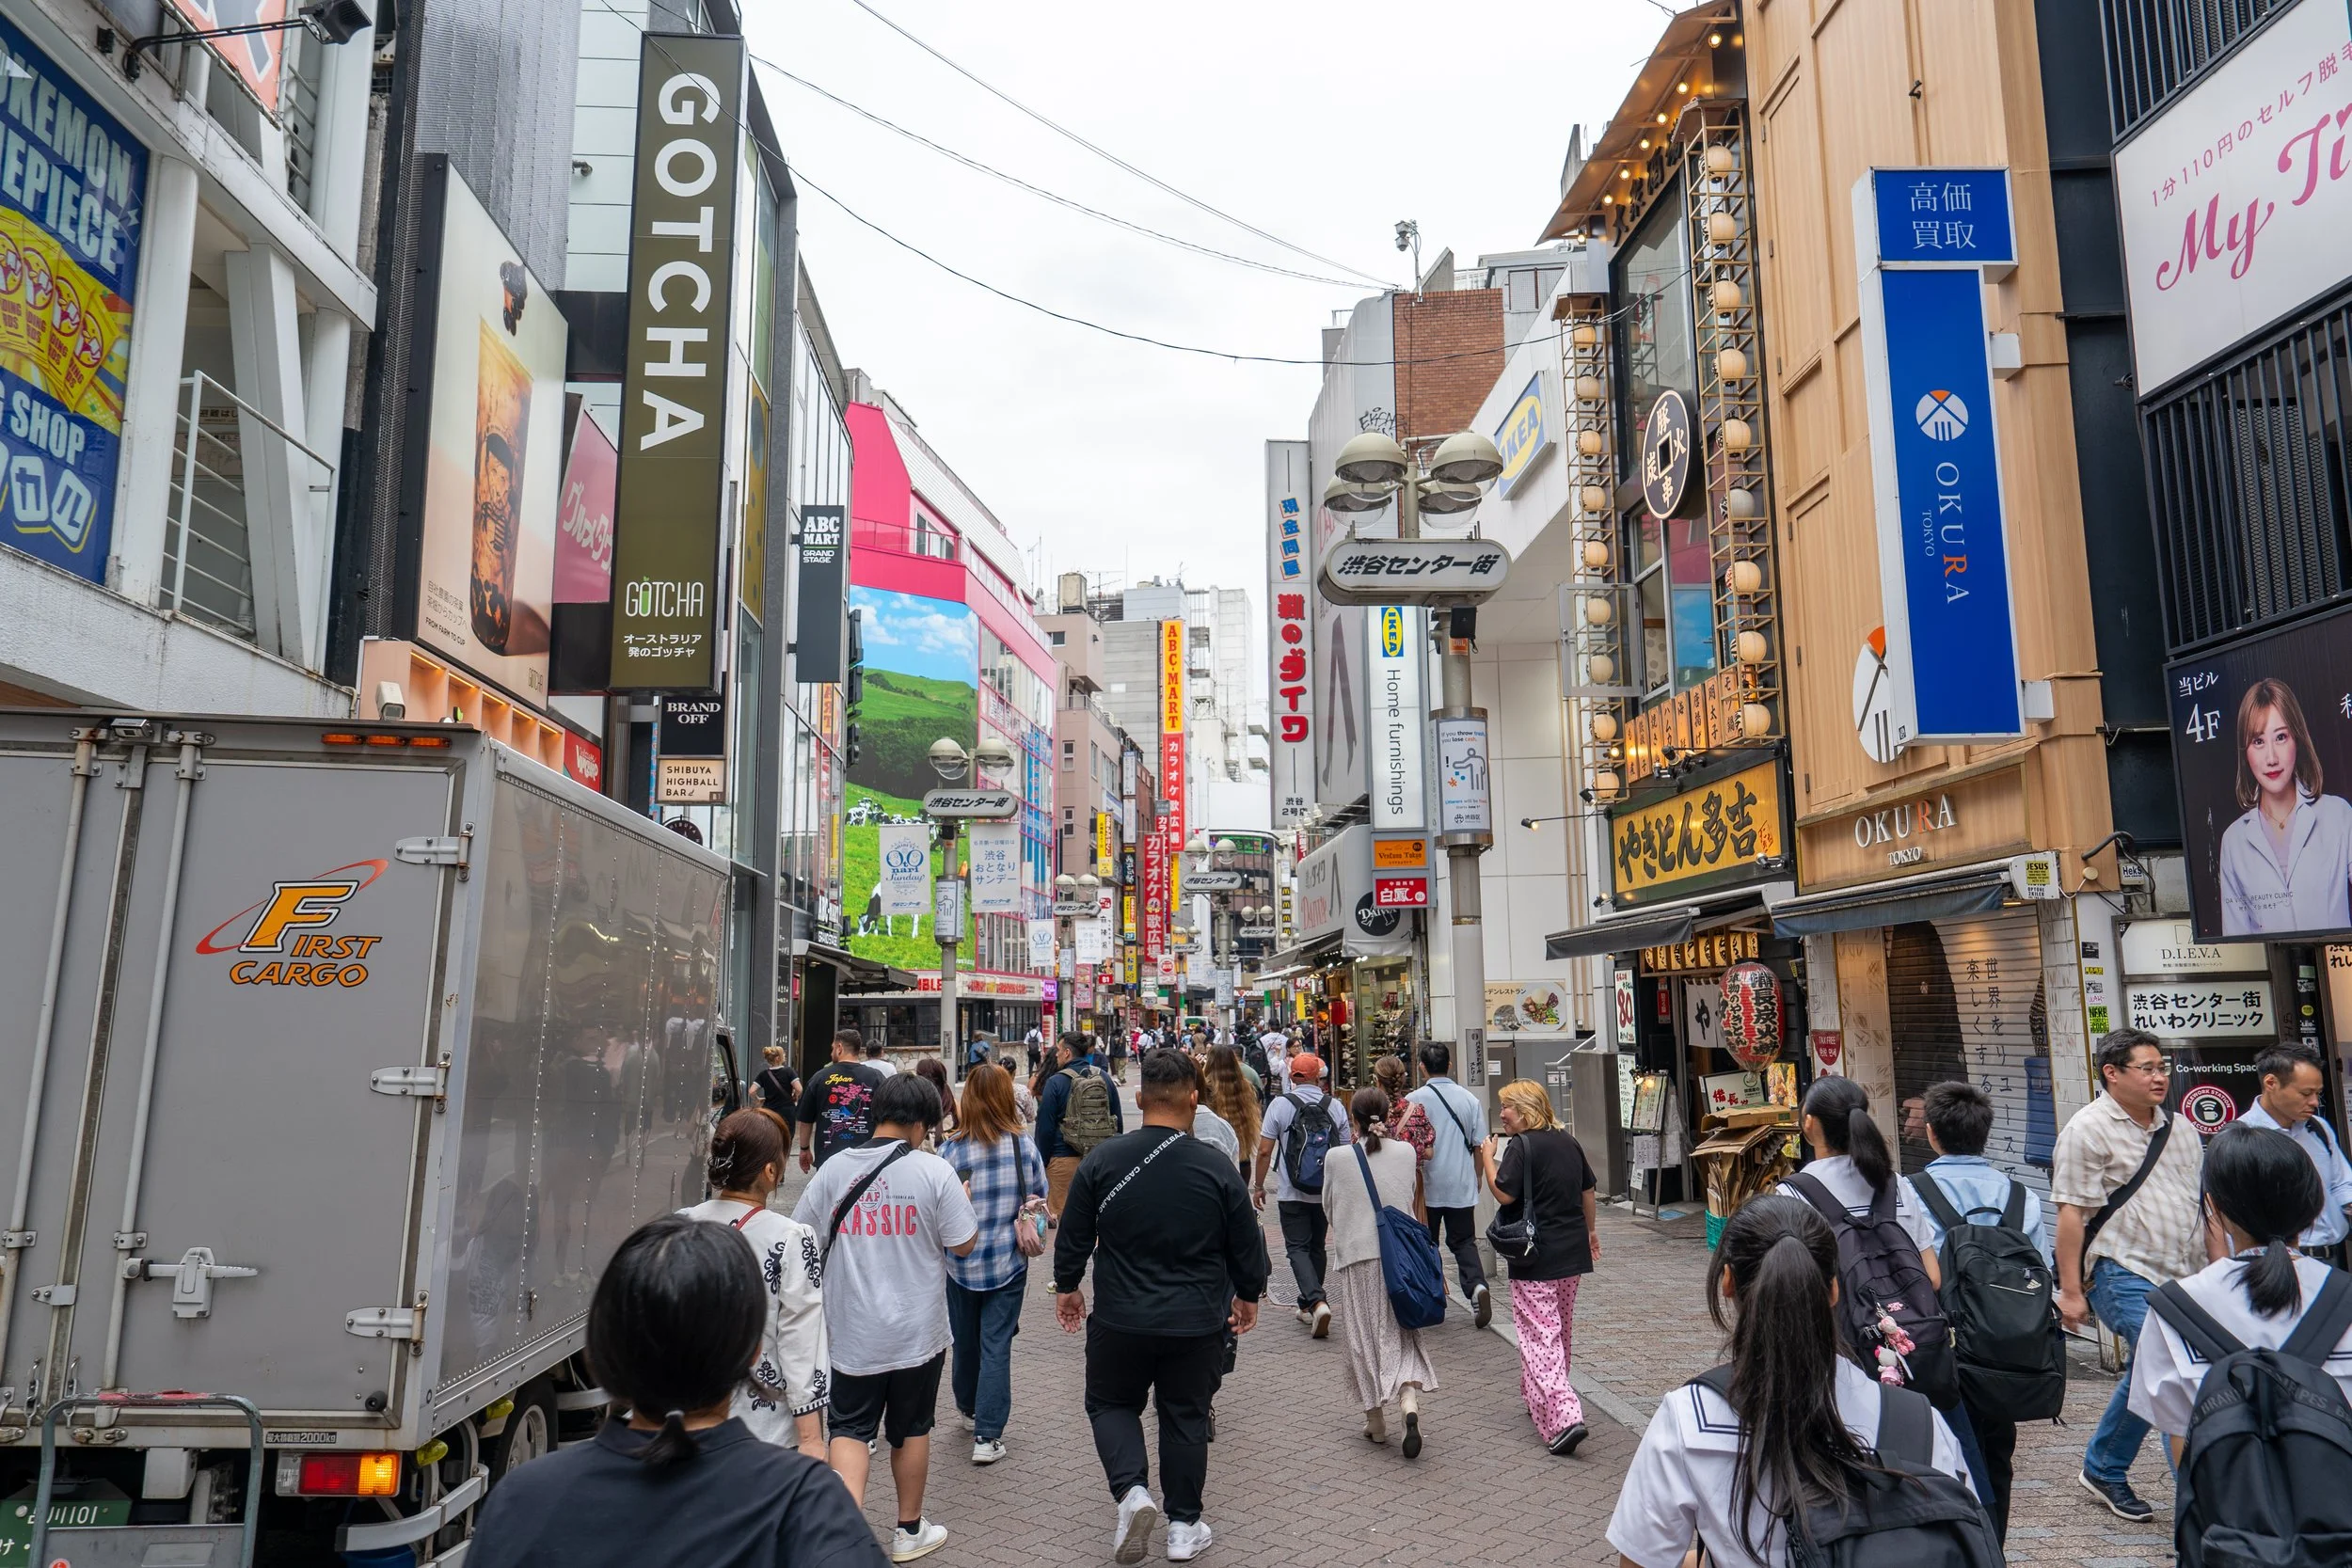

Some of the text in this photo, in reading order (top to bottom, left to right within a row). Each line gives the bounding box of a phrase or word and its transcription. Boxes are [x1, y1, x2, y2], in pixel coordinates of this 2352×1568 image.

[0, 38, 132, 209] KEMON
[0, 120, 120, 276] EPIECE
[1909, 182, 1972, 214] 高価
[1913, 220, 1976, 249] 買取
[2156, 193, 2275, 291] My
[641, 72, 722, 451] GOTCHA
[10, 389, 86, 466] SHOP
[1501, 405, 1539, 465] IKEA
[1646, 401, 1687, 509] 炭 火 豚 串
[563, 481, 612, 576] グルメタウ
[803, 515, 840, 532] ABC
[1920, 509, 1935, 557] TOKYO
[1935, 462, 1969, 604] OKURA
[803, 532, 840, 546] MART
[1337, 554, 1500, 576] 渋谷センター街
[625, 576, 704, 618] GOTCHA
[425, 616, 438, 630] FROM
[438, 625, 451, 638] FARM
[457, 636, 466, 645] CUP
[624, 633, 702, 644] オーストラリア
[1384, 610, 1398, 654] IKEA
[628, 646, 695, 657] 発のゴッチャ
[1278, 594, 1309, 743] 靴のダイワ
[2179, 672, 2219, 697] 当ビル
[667, 702, 721, 713] BRAND
[677, 714, 709, 724] OFF
[1708, 685, 1718, 739] 明太子
[2185, 704, 2220, 743] 4F
[1386, 669, 1404, 816] Home furnishings
[929, 797, 1009, 808] 渋谷センター街
[1285, 797, 1303, 806] 渋谷
[1619, 781, 1757, 883] やきとん多吉
[1855, 793, 1957, 847] OKURA
[975, 862, 1016, 873] おとなり
[984, 850, 1006, 861] 渋谷
[1146, 834, 1163, 896] カラオケ
[1888, 847, 1922, 866] TOKYO
[975, 874, 1016, 884] サンデー
[1185, 877, 1237, 885] 渋谷センター街
[2161, 948, 2221, 959] D.I.E.V.A
[230, 960, 369, 988] CARGO
[1617, 989, 1633, 1028] 80
[2133, 991, 2262, 1011] 渋谷センター街
[1966, 958, 1993, 1092] 楽しくする
[2135, 1011, 2264, 1029] れいわクリニック
[1827, 1036, 1836, 1044] FREE
[825, 1074, 854, 1085] Japan
[2176, 1063, 2259, 1074] Co-working Spac
[2185, 1088, 2232, 1108] TELEWORK STATION
[1098, 1166, 1140, 1213] CASTELBAJAC
